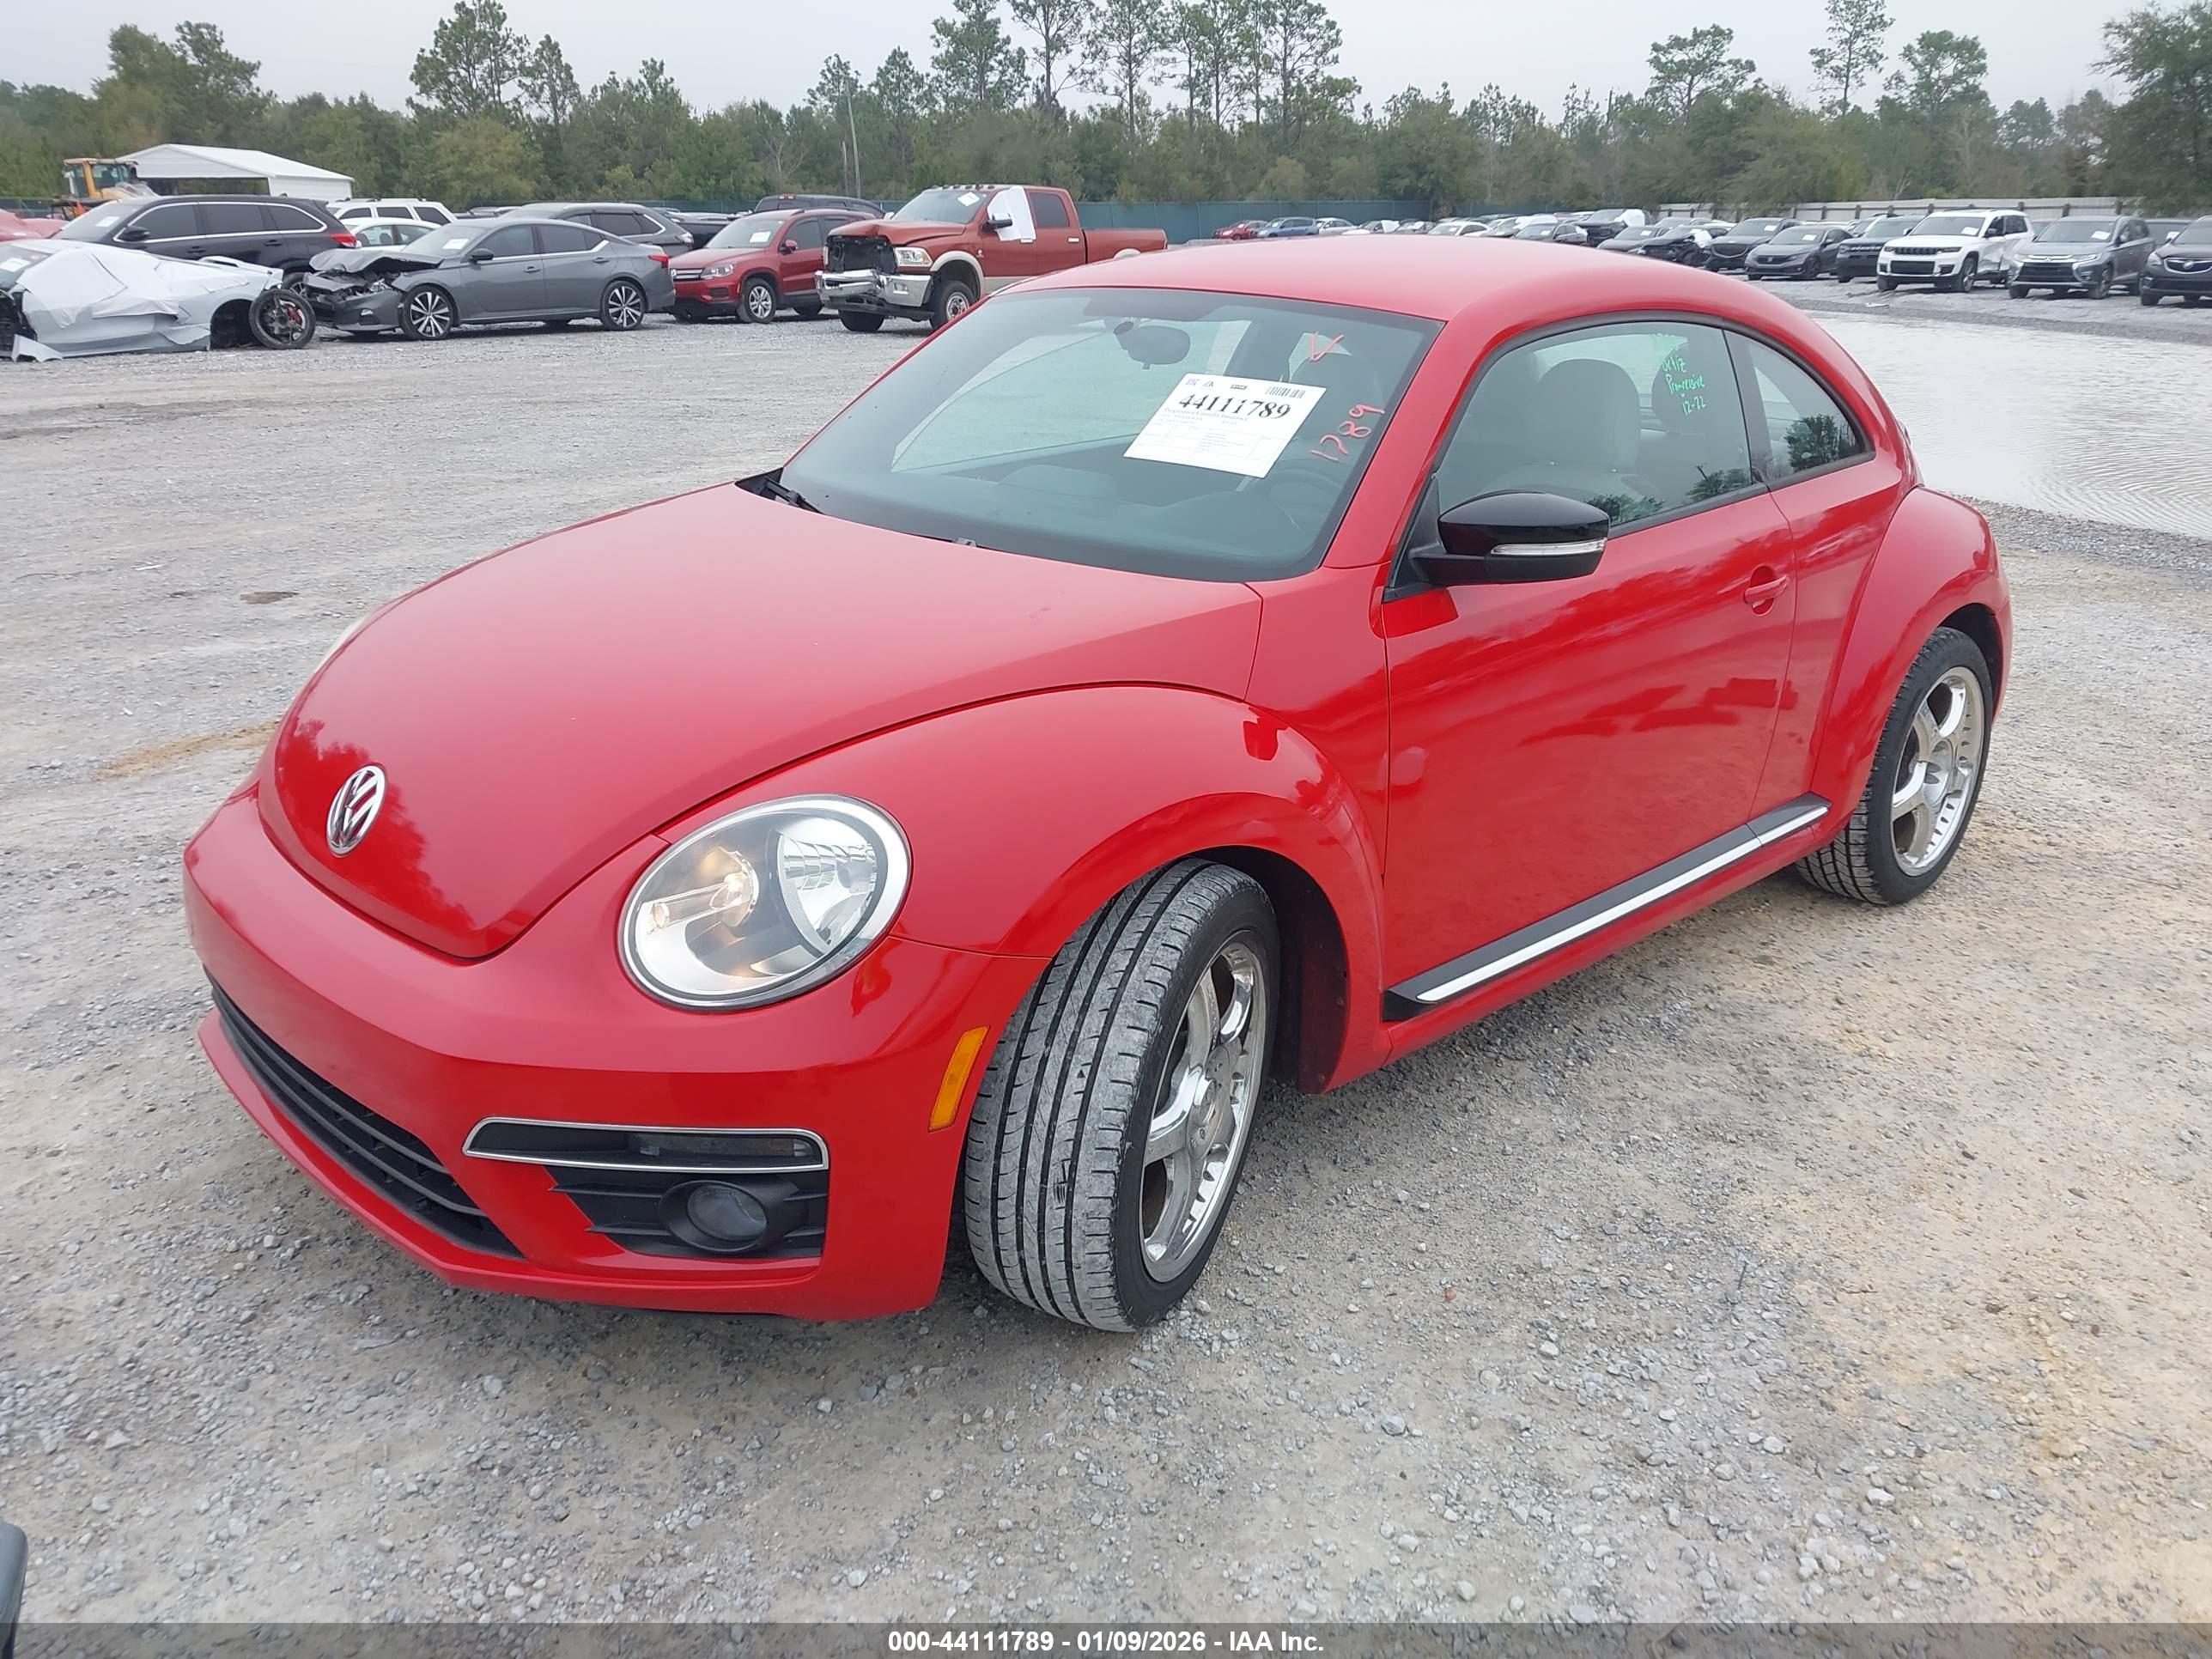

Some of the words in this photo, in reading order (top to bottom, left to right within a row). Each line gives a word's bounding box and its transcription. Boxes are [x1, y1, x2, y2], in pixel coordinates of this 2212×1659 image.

[1178, 393, 1291, 420] 44111789
[1682, 395, 1706, 416] 12-22
[1310, 404, 1386, 462] 1789
